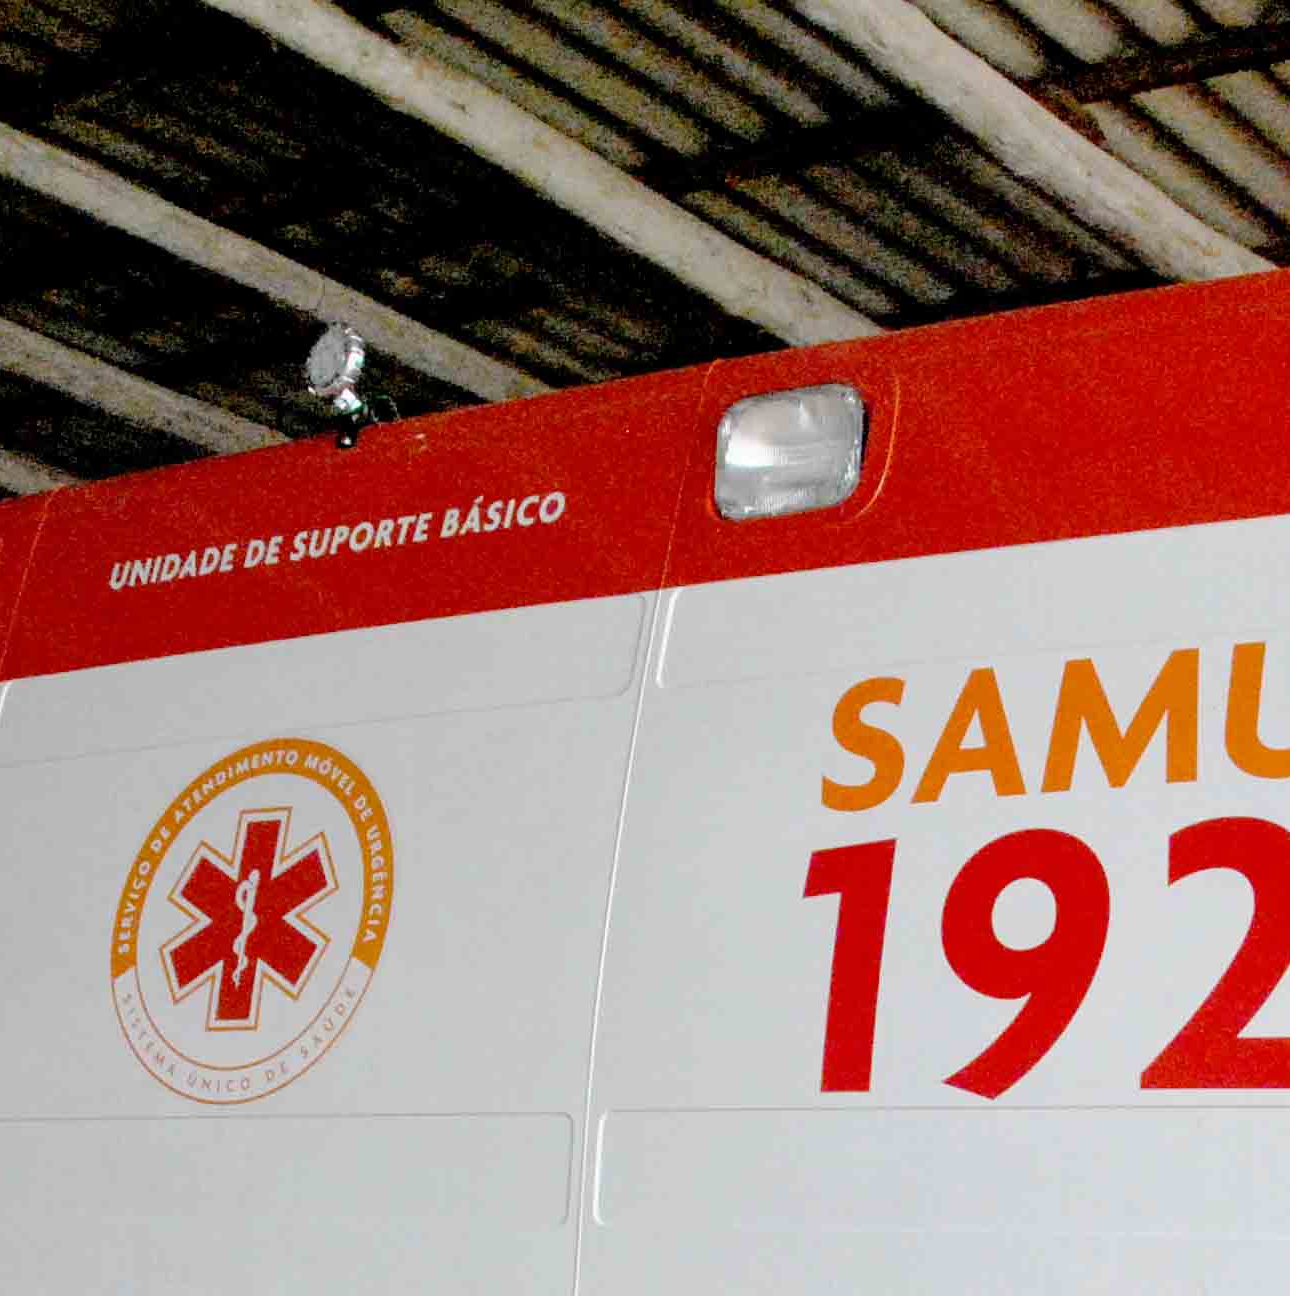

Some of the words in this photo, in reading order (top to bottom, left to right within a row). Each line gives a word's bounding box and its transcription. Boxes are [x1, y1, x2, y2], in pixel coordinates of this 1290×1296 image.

[109, 542, 235, 591] UNIDADE
[243, 536, 282, 569] DE
[289, 513, 432, 562] SUPORTE
[439, 490, 567, 540] BÁSICO
[171, 749, 299, 826] ATENDIMENTO
[304, 752, 357, 798] MÓVEL
[352, 792, 374, 823] DE
[150, 828, 172, 852] DE
[116, 861, 151, 955] SERVIÇO
[361, 824, 391, 945] URGÊNCIA
[264, 1060, 289, 1083] DE
